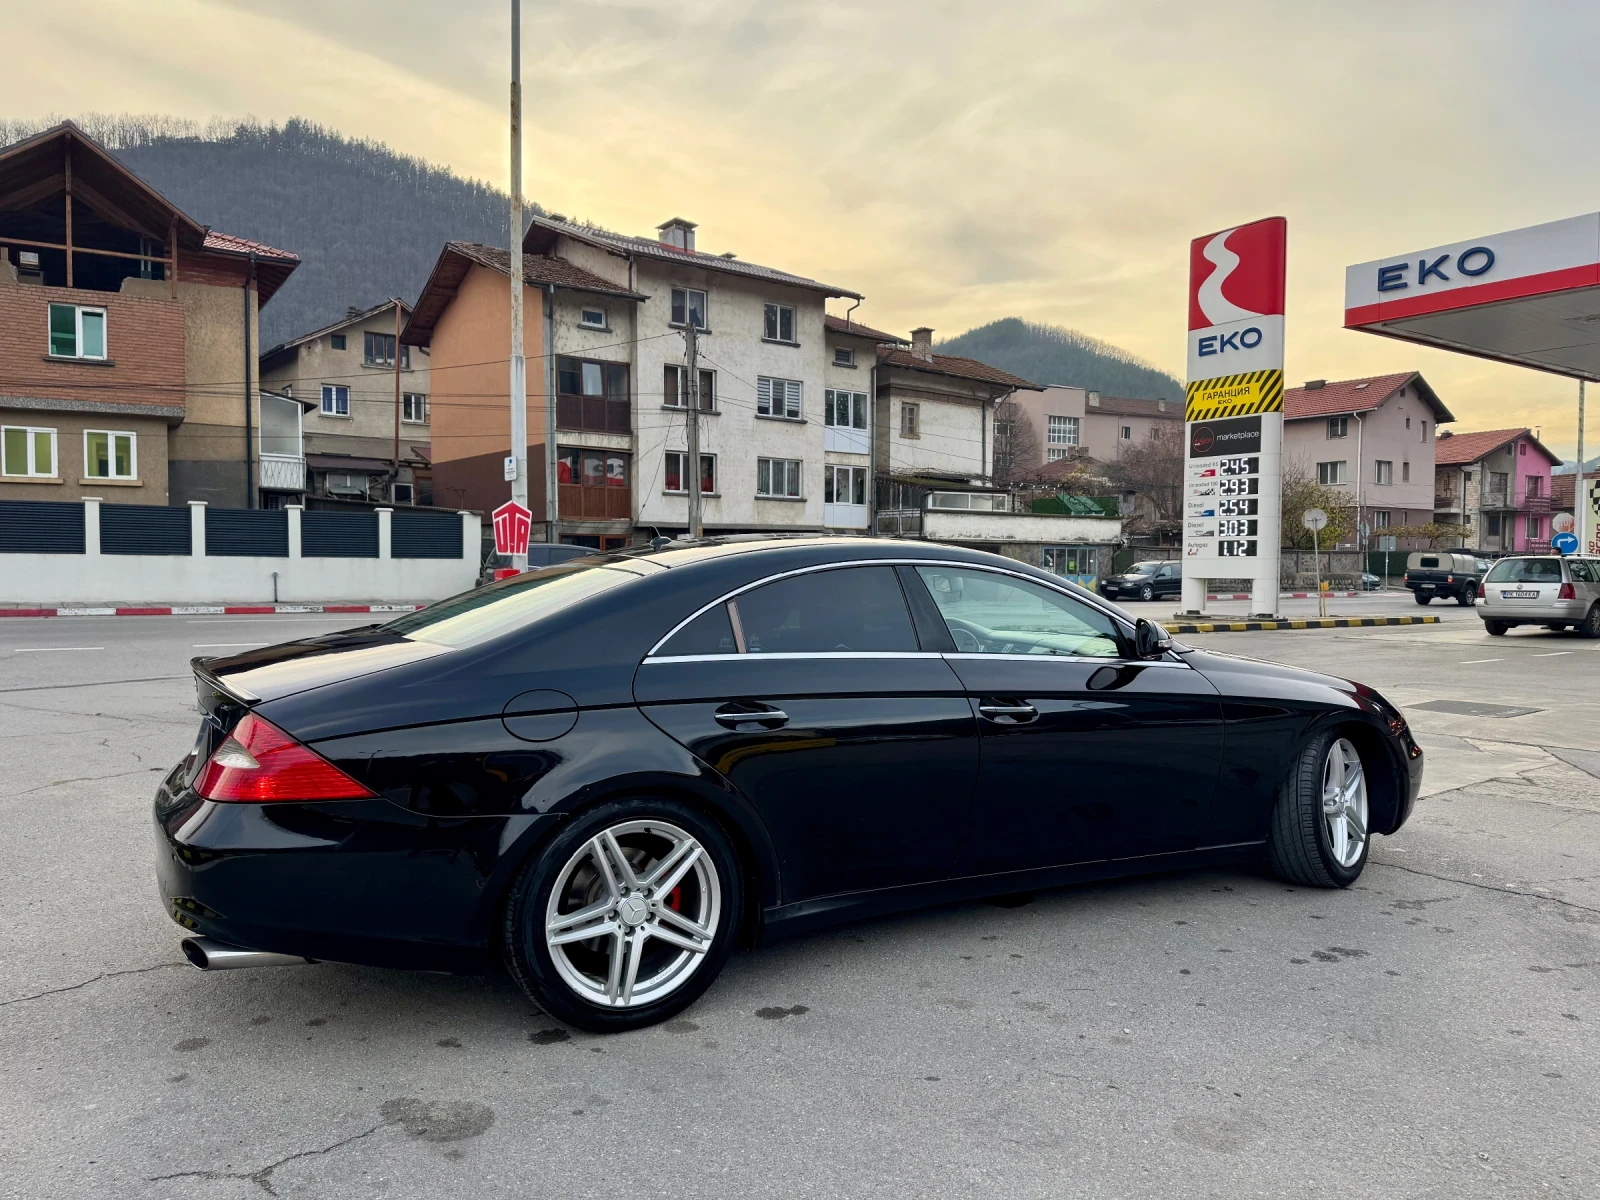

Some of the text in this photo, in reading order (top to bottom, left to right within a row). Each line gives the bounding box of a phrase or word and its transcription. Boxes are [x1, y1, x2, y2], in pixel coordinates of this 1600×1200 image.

[1377, 246, 1495, 292] EKO
[1198, 327, 1263, 357] EKO
[1202, 386, 1250, 401] ГАРАНЦИЯ
[1216, 430, 1260, 442] marketplace
[1220, 457, 1249, 476] 2.45
[1220, 478, 1249, 496] 2.93
[1219, 499, 1249, 516] 2.54
[1219, 519, 1248, 537] 3.03
[1223, 540, 1248, 557] 1.12
